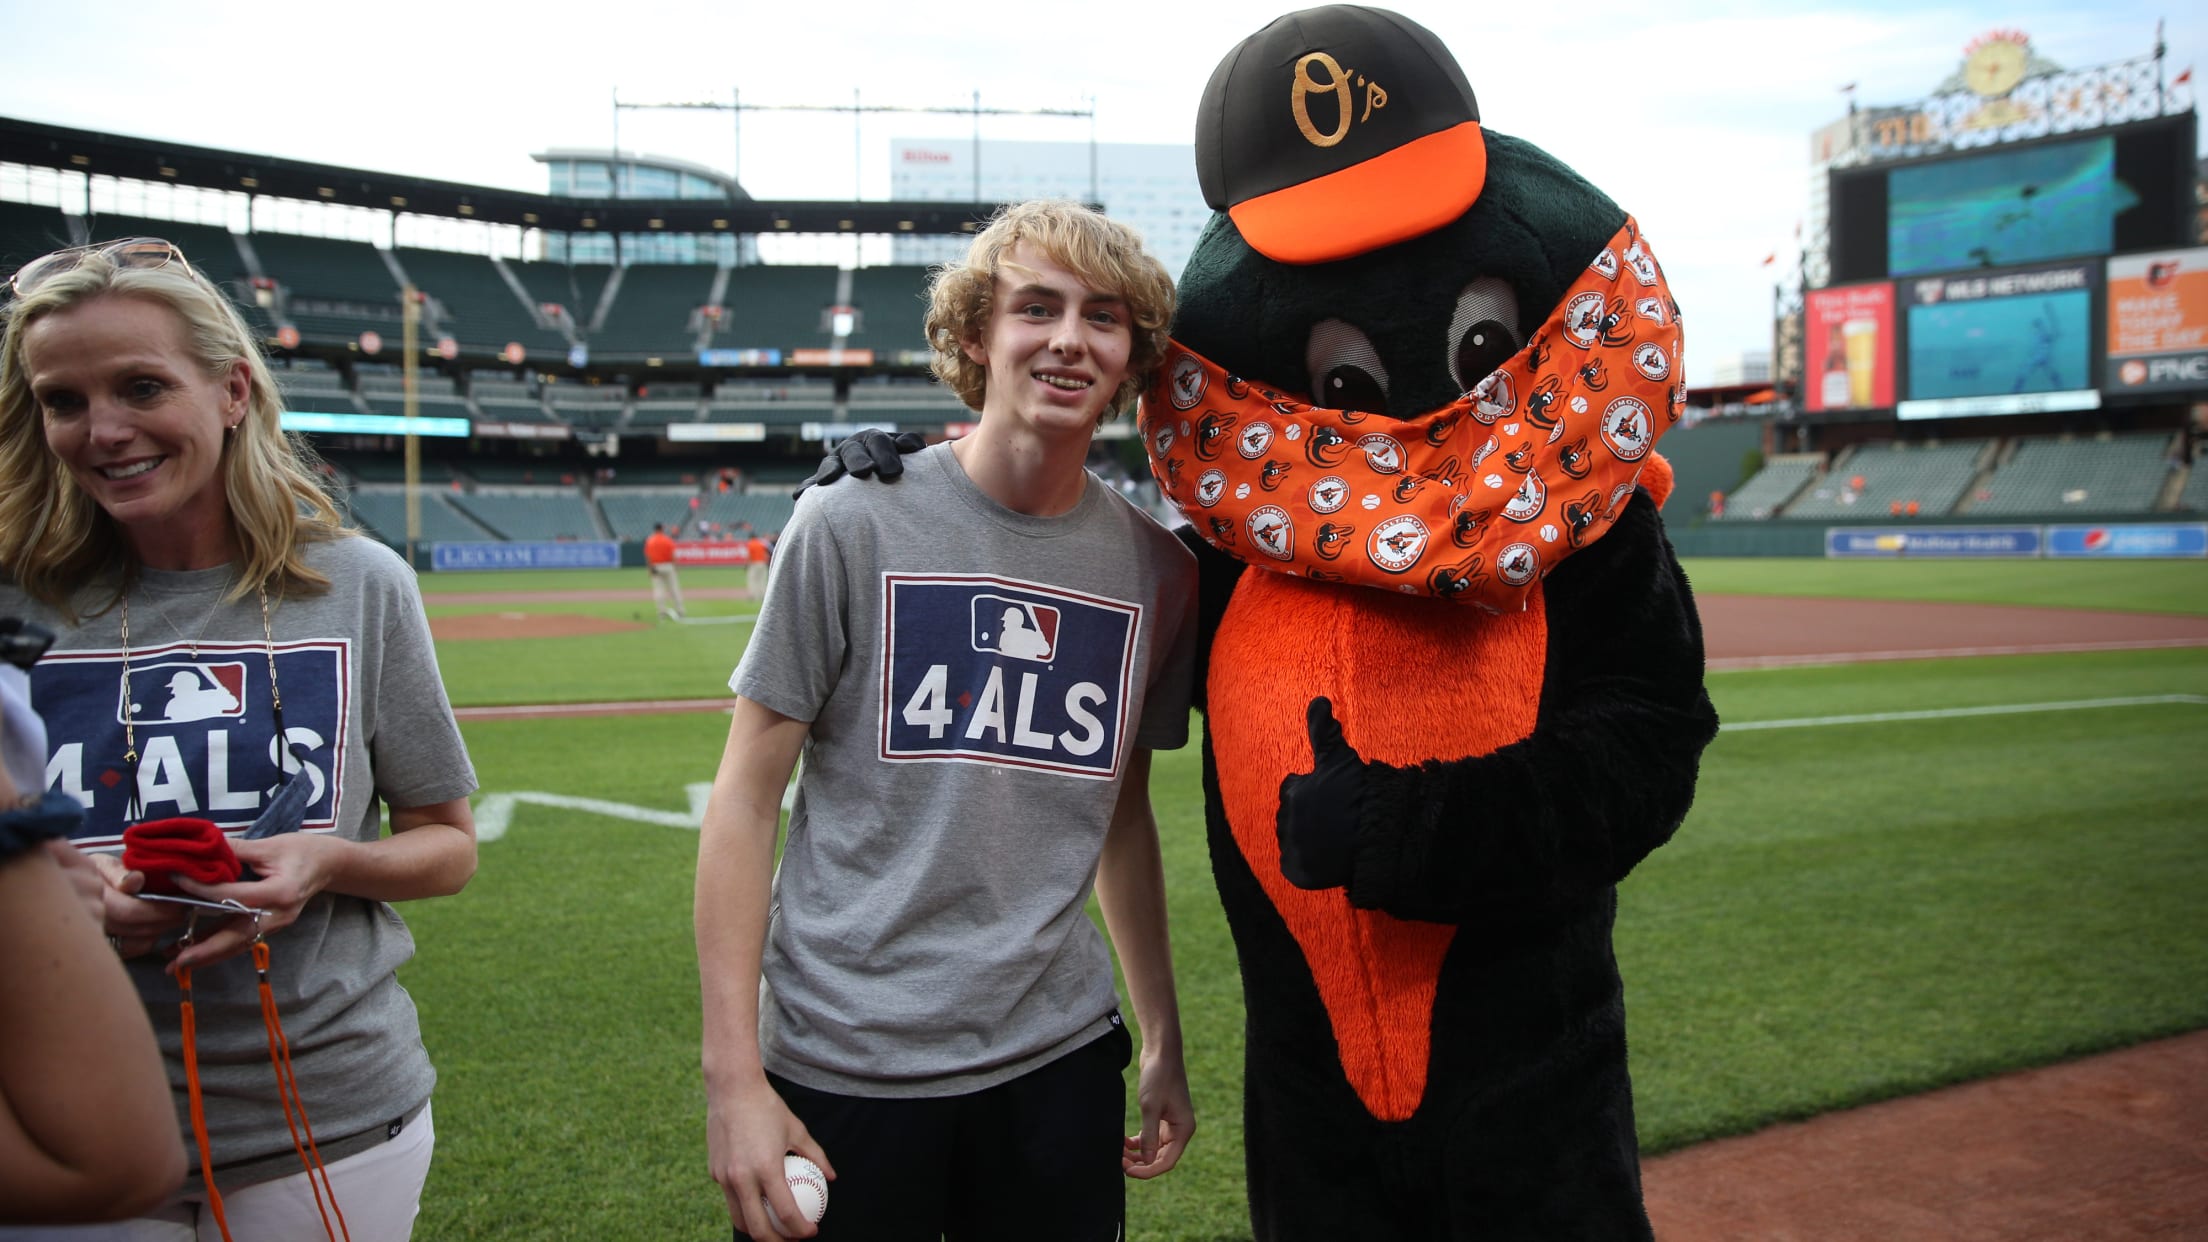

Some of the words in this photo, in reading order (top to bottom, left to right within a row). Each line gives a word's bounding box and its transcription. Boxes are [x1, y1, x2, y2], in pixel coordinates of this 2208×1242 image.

[1291, 51, 1388, 148] O's
[1990, 267, 2087, 295] NETWORK
[2148, 356, 2208, 382] PNC
[1603, 399, 1645, 432] BALTIMORE
[1617, 431, 1652, 457] ORIOLES
[1249, 507, 1290, 529] BALTIMORE
[1506, 492, 1542, 518] ORIOLES
[902, 664, 953, 739] 4
[964, 665, 1108, 756] ALS
[46, 742, 94, 809] 4
[124, 727, 325, 822] ALS
